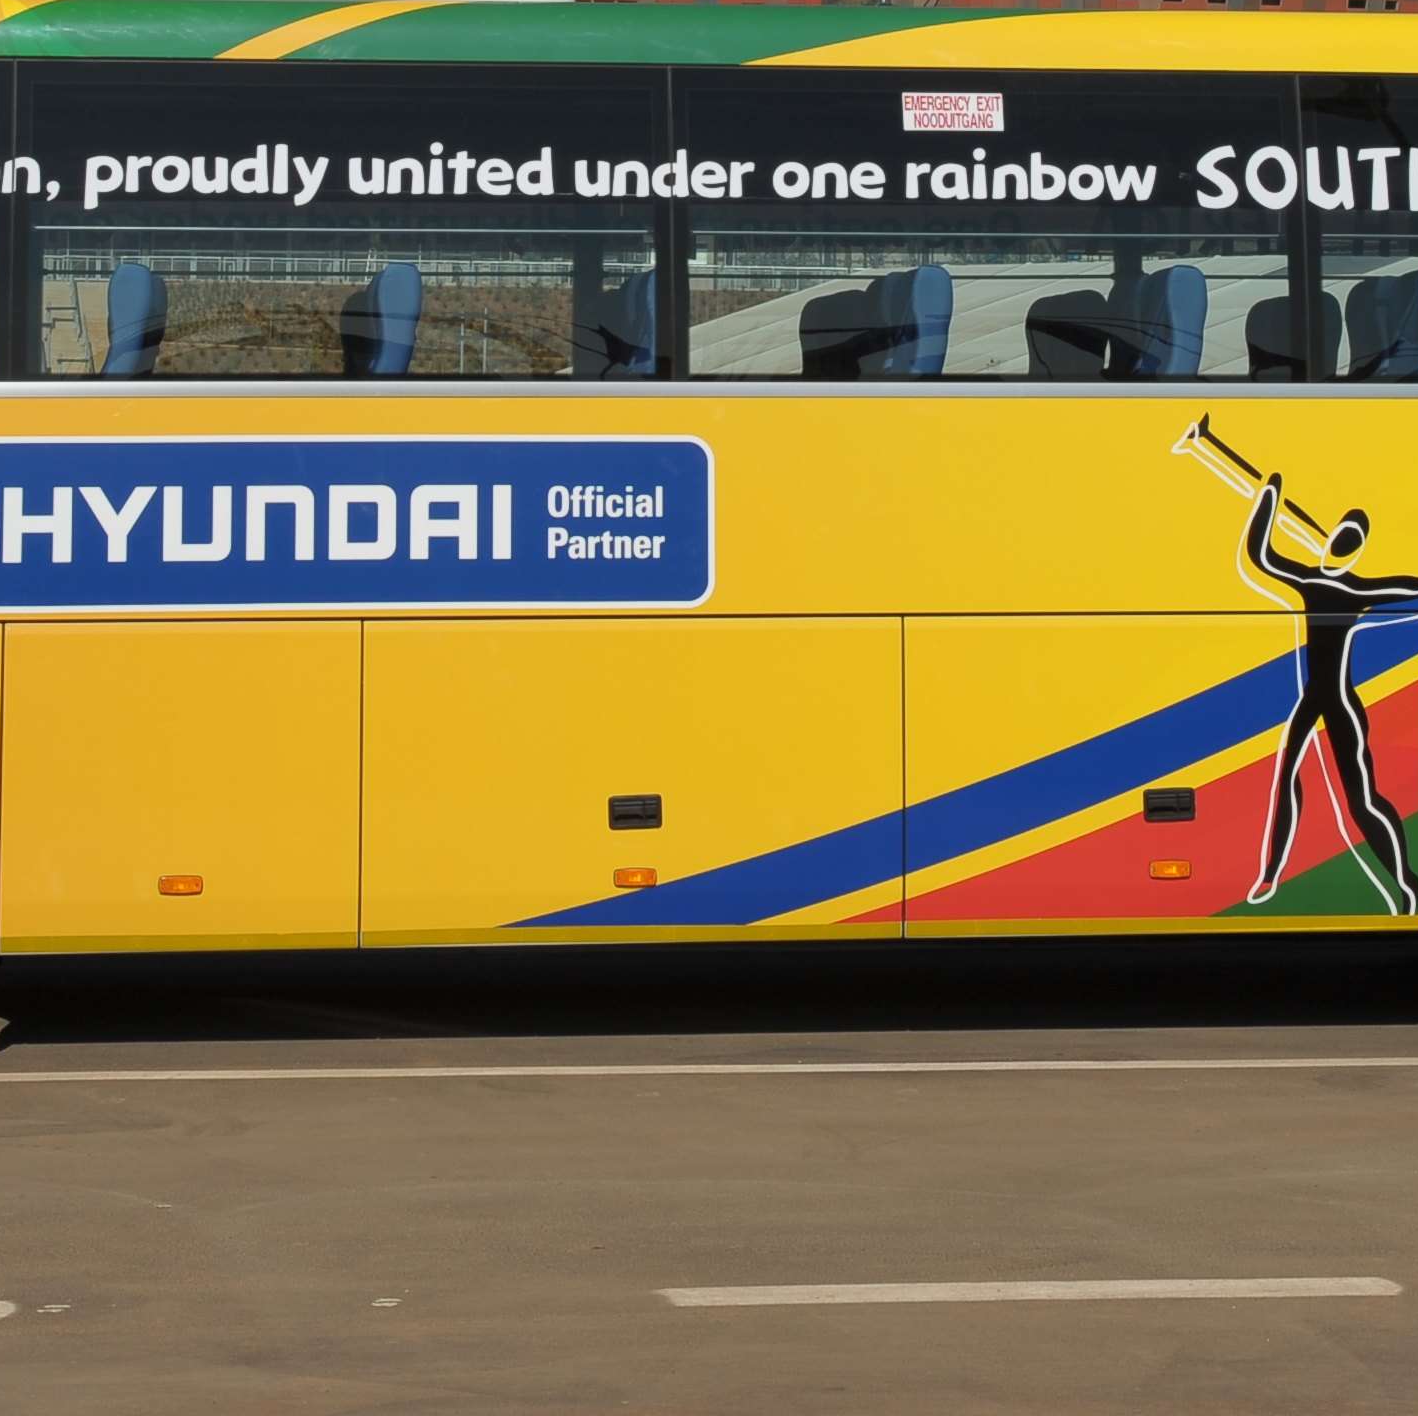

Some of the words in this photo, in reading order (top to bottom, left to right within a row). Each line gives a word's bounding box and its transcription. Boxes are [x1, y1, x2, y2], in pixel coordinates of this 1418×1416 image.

[904, 96, 970, 111] EMERGENCY
[976, 96, 1001, 112] EXIT
[913, 113, 994, 129] NOODUITGANG
[83, 143, 330, 210] proudly
[348, 141, 555, 196] united
[574, 141, 756, 199] under
[772, 161, 886, 200] one
[905, 147, 1157, 202] rainbow
[547, 484, 664, 519] Official
[2, 484, 512, 564] HYUNDAI
[547, 527, 666, 560] Partner
